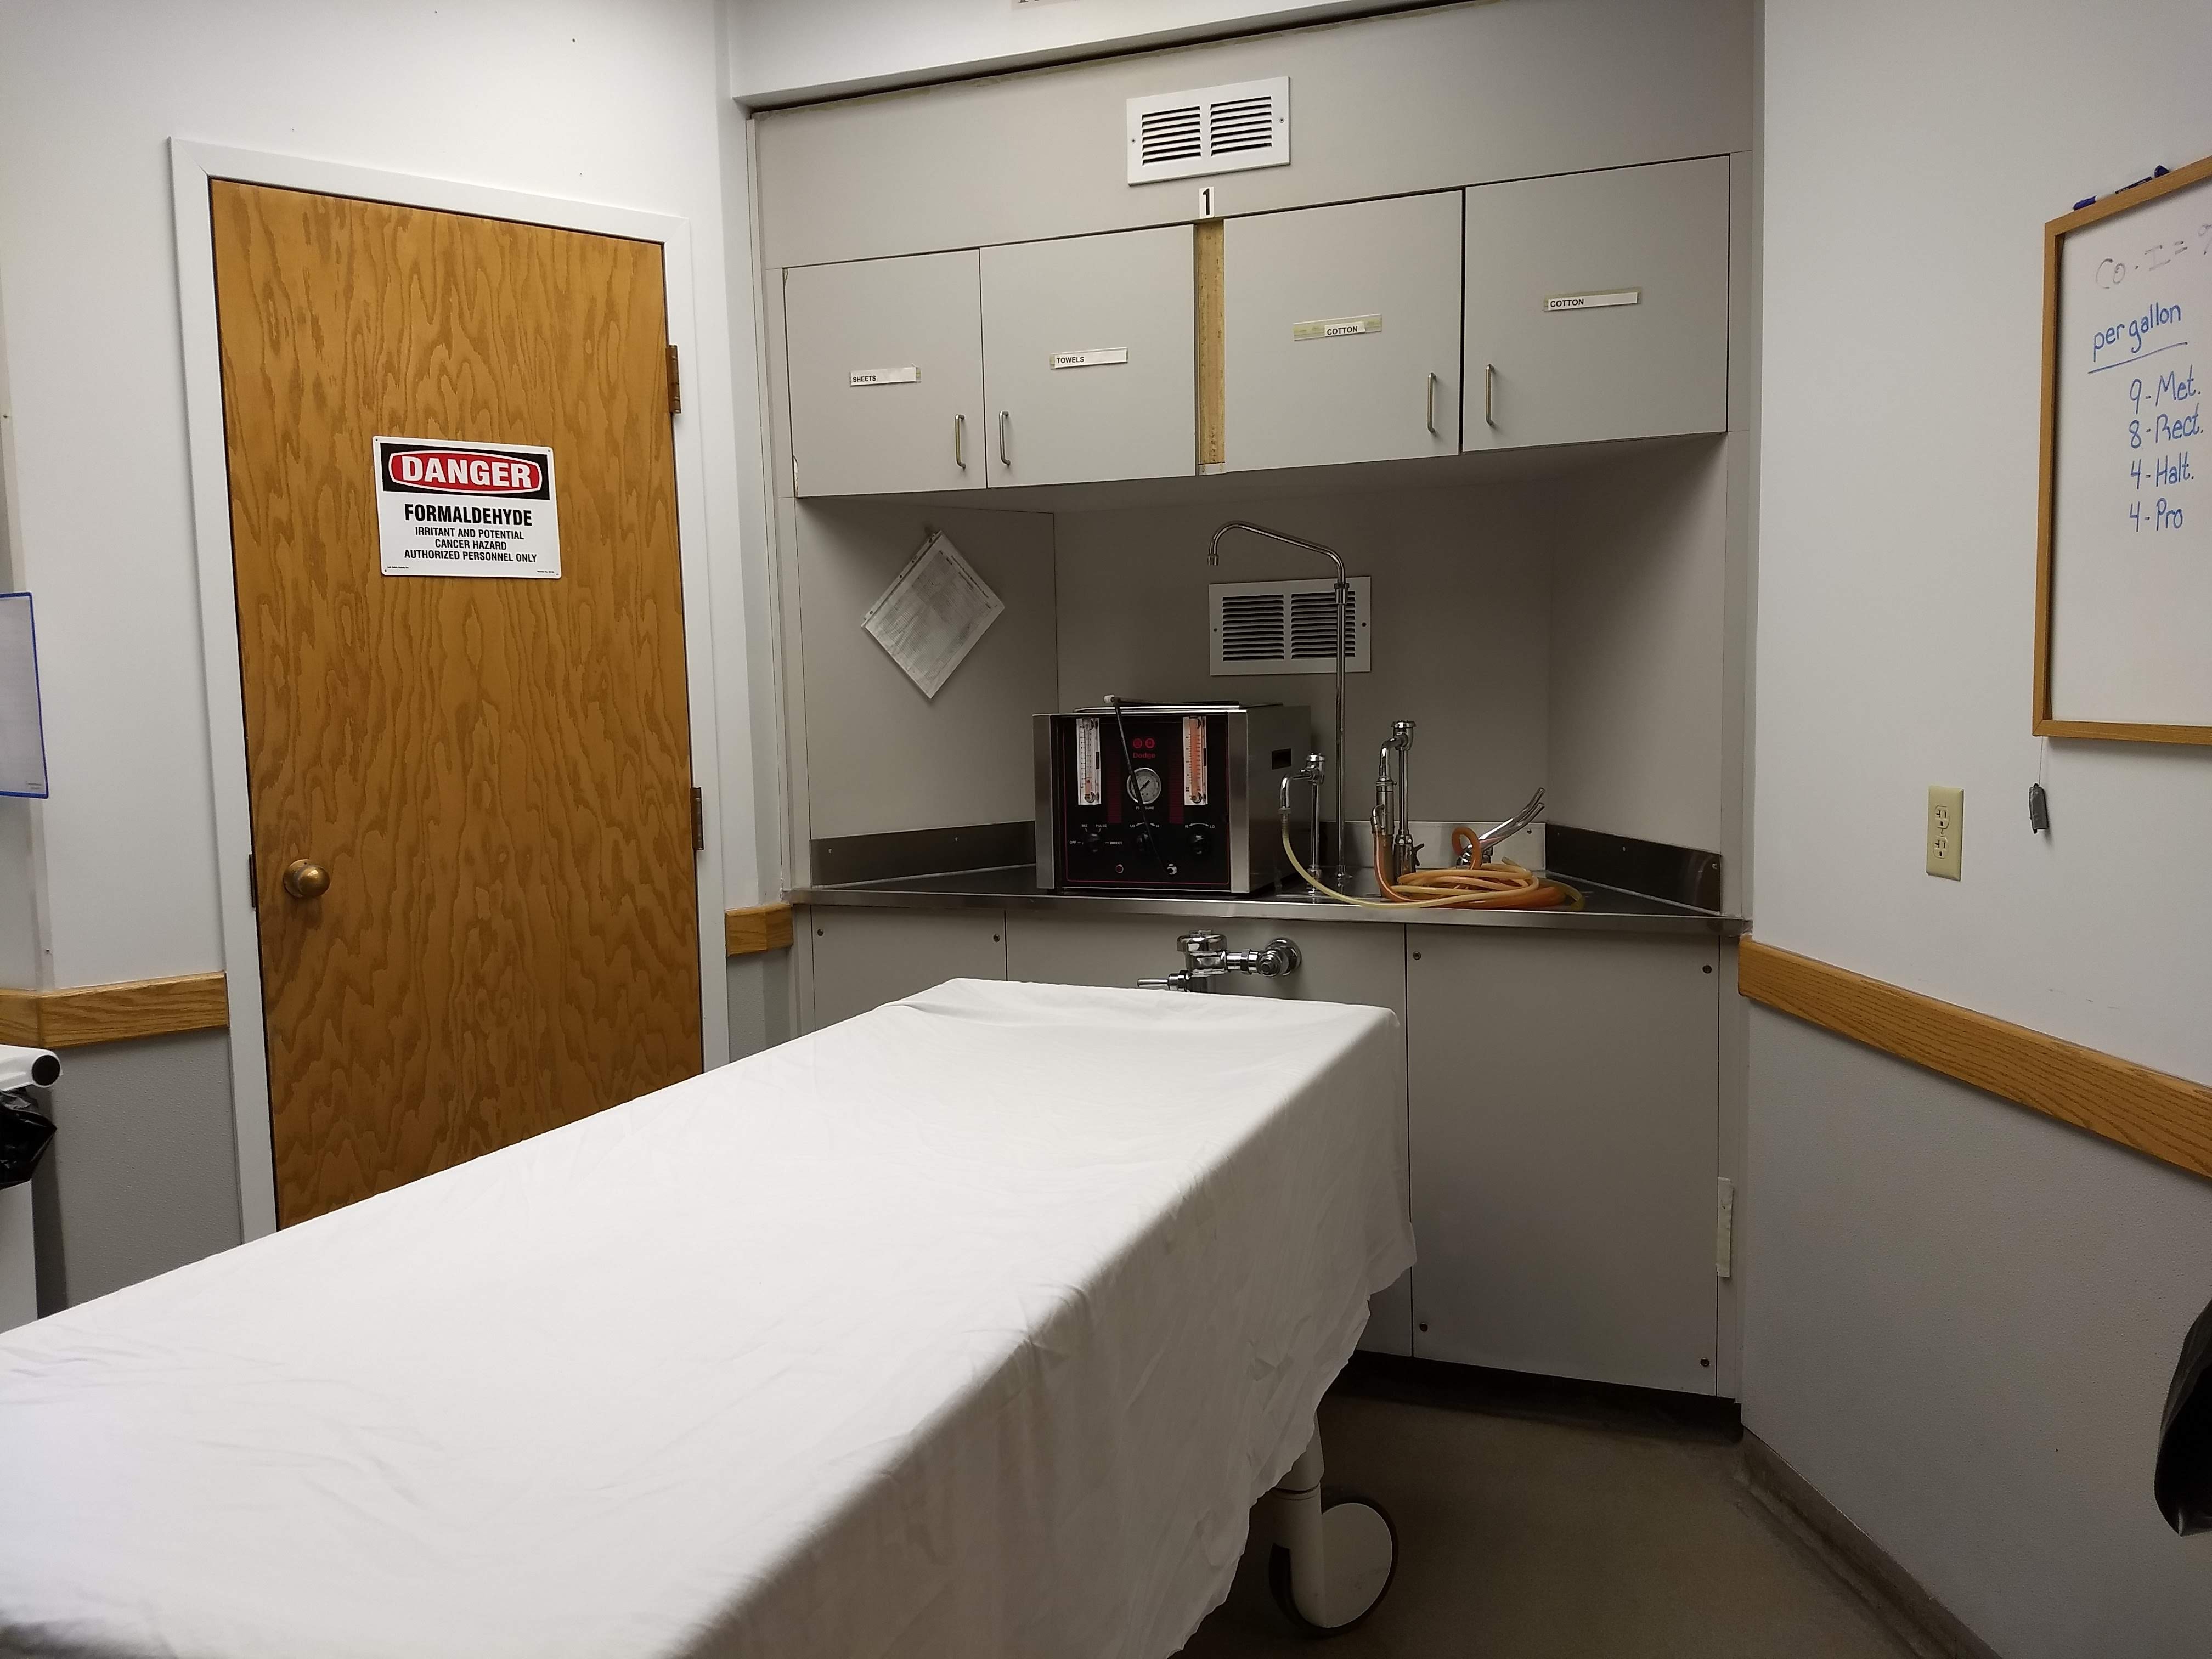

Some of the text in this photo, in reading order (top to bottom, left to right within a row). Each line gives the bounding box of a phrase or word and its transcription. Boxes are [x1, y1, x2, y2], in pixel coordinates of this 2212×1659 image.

[1202, 188, 1210, 216] 1
[1550, 298, 1584, 307] COTTON
[1327, 325, 1358, 335] COTTON
[2094, 302, 2182, 363] per gallon
[852, 375, 877, 383] SHEETS
[401, 455, 533, 488] DANGER
[404, 504, 533, 527] FORMALDEHYDE
[415, 526, 524, 540] IRRITANT AND POTENTIAL
[435, 539, 507, 550] CANCER HAZARD
[404, 550, 538, 563] AUTHORIZED PERSONNEL ONLY
